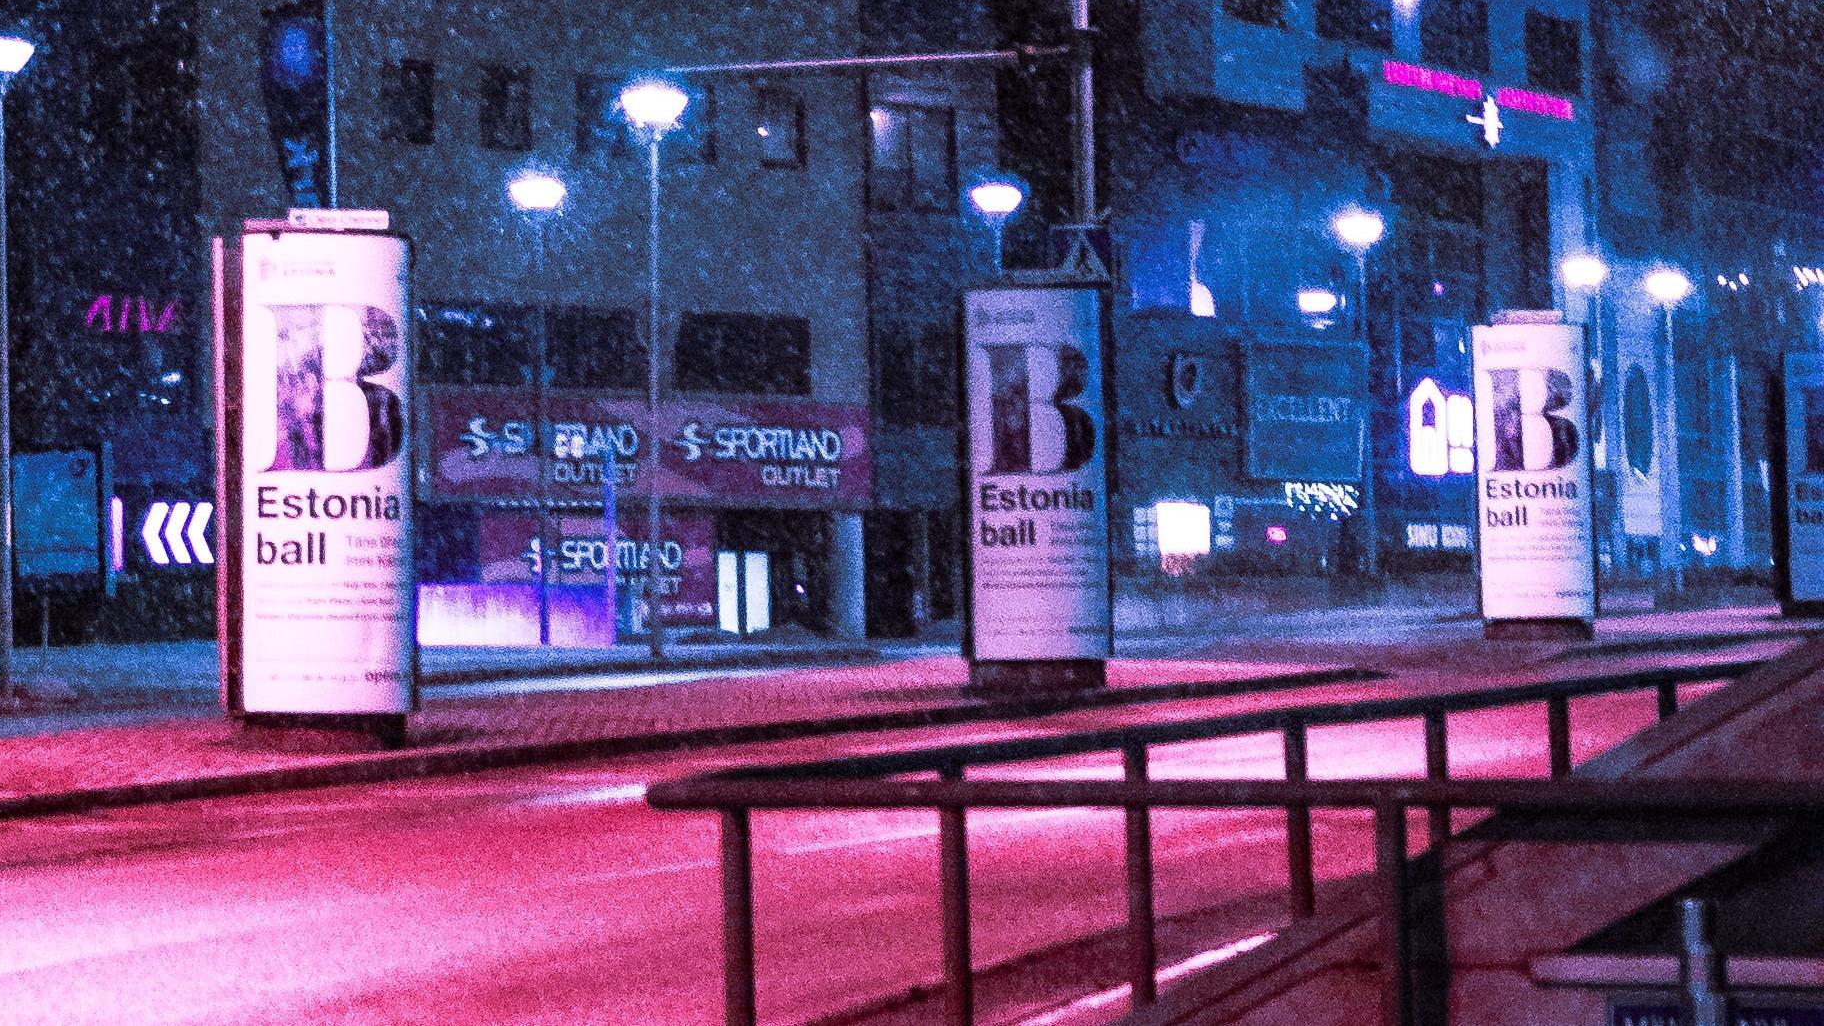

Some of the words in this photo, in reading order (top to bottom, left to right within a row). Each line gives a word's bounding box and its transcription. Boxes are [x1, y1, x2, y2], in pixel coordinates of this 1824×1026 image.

[255, 303, 403, 473] B
[977, 343, 1096, 475] B
[1483, 367, 1579, 472] B
[714, 427, 842, 462] SPORTLAND
[761, 464, 842, 489] OUTLET
[1486, 477, 1578, 500] Estonia
[257, 485, 401, 520] Estonia
[979, 482, 1094, 513] Estonia
[979, 518, 1036, 548] ball
[1486, 506, 1528, 528] ball
[256, 531, 327, 565] ball
